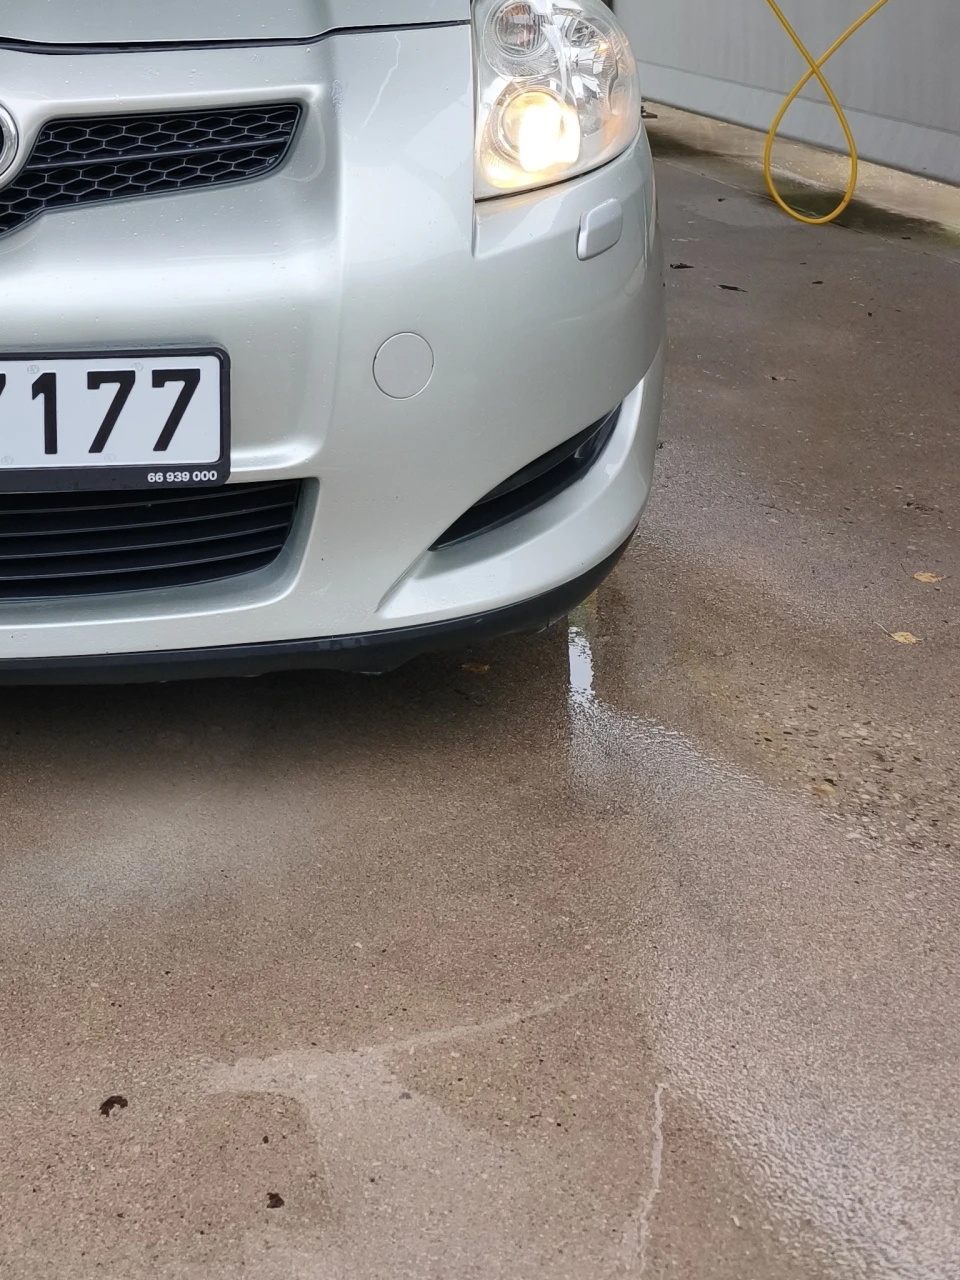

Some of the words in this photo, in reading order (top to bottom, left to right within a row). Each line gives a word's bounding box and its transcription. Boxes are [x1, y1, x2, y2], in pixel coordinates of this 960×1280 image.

[147, 471, 164, 483] 66
[166, 470, 190, 482] 939
[192, 470, 218, 481] 000
